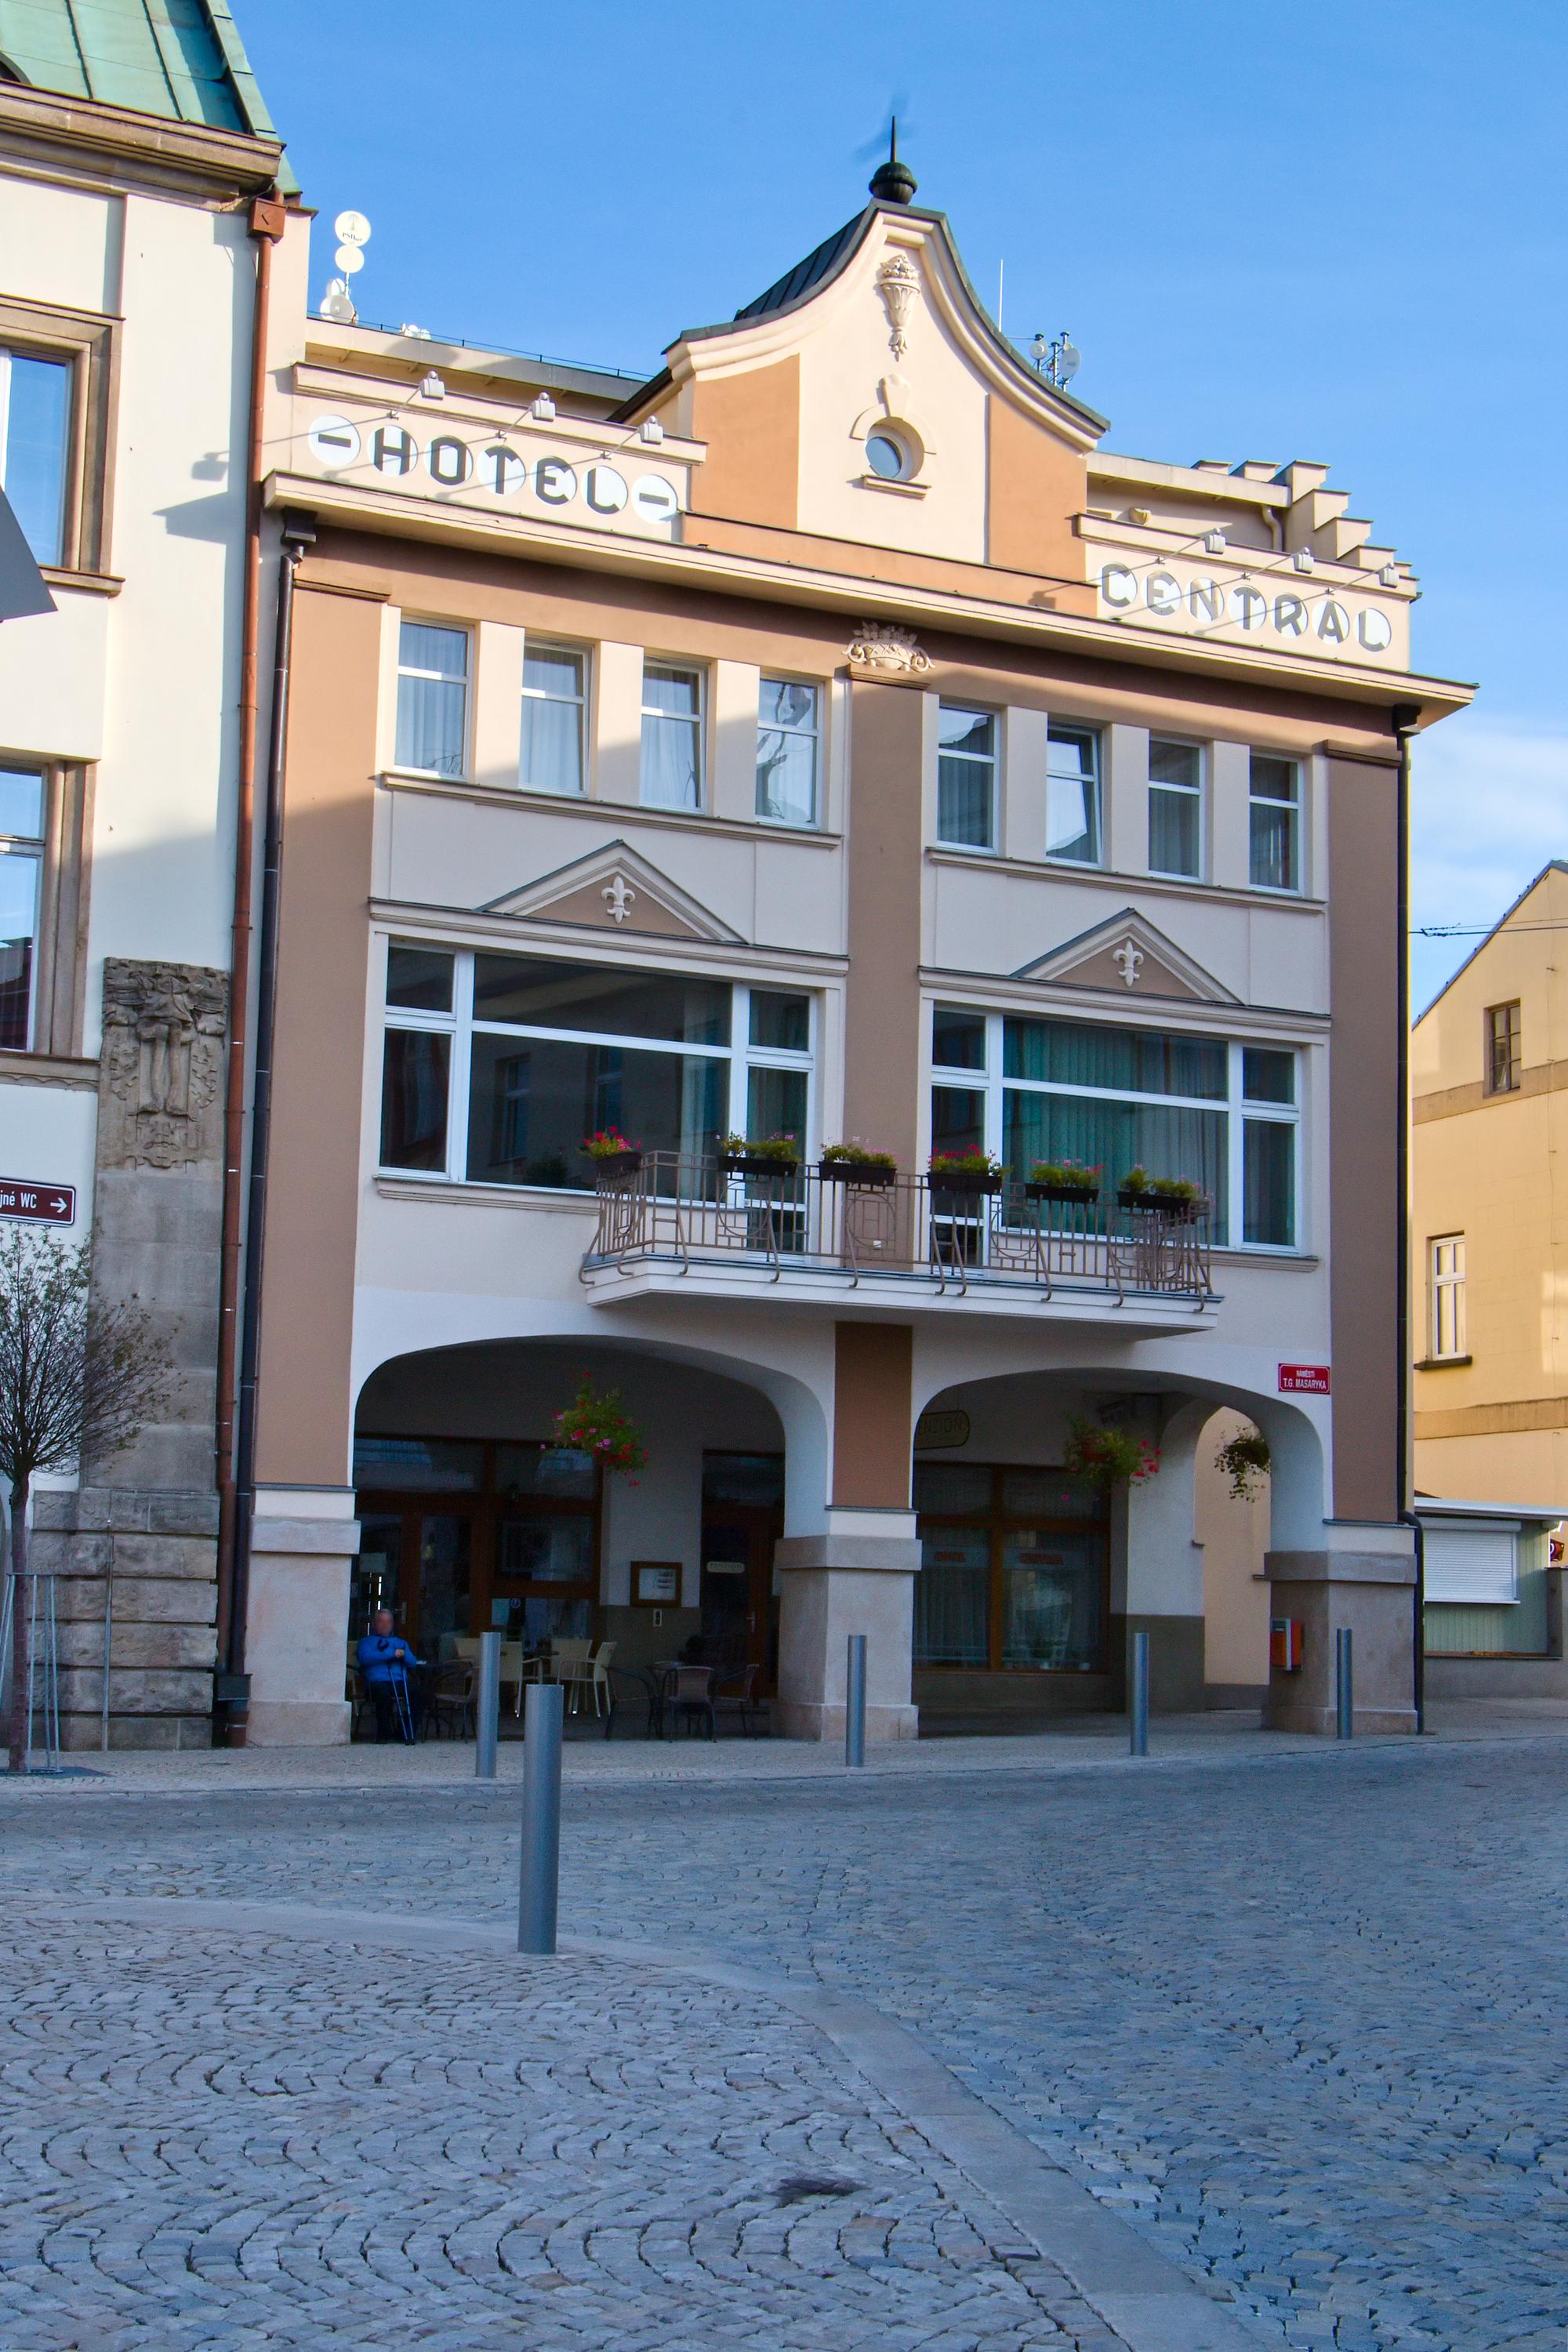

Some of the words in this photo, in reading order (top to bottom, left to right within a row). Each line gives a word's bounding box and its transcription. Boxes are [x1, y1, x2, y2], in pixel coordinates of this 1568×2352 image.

[372, 425, 621, 515] HOTEL
[1102, 562, 1386, 652] CENTRAL
[20, 1192, 37, 1209] WC
[1283, 1377, 1294, 1388] T.G.
[1295, 1378, 1327, 1390] MASARYKA
